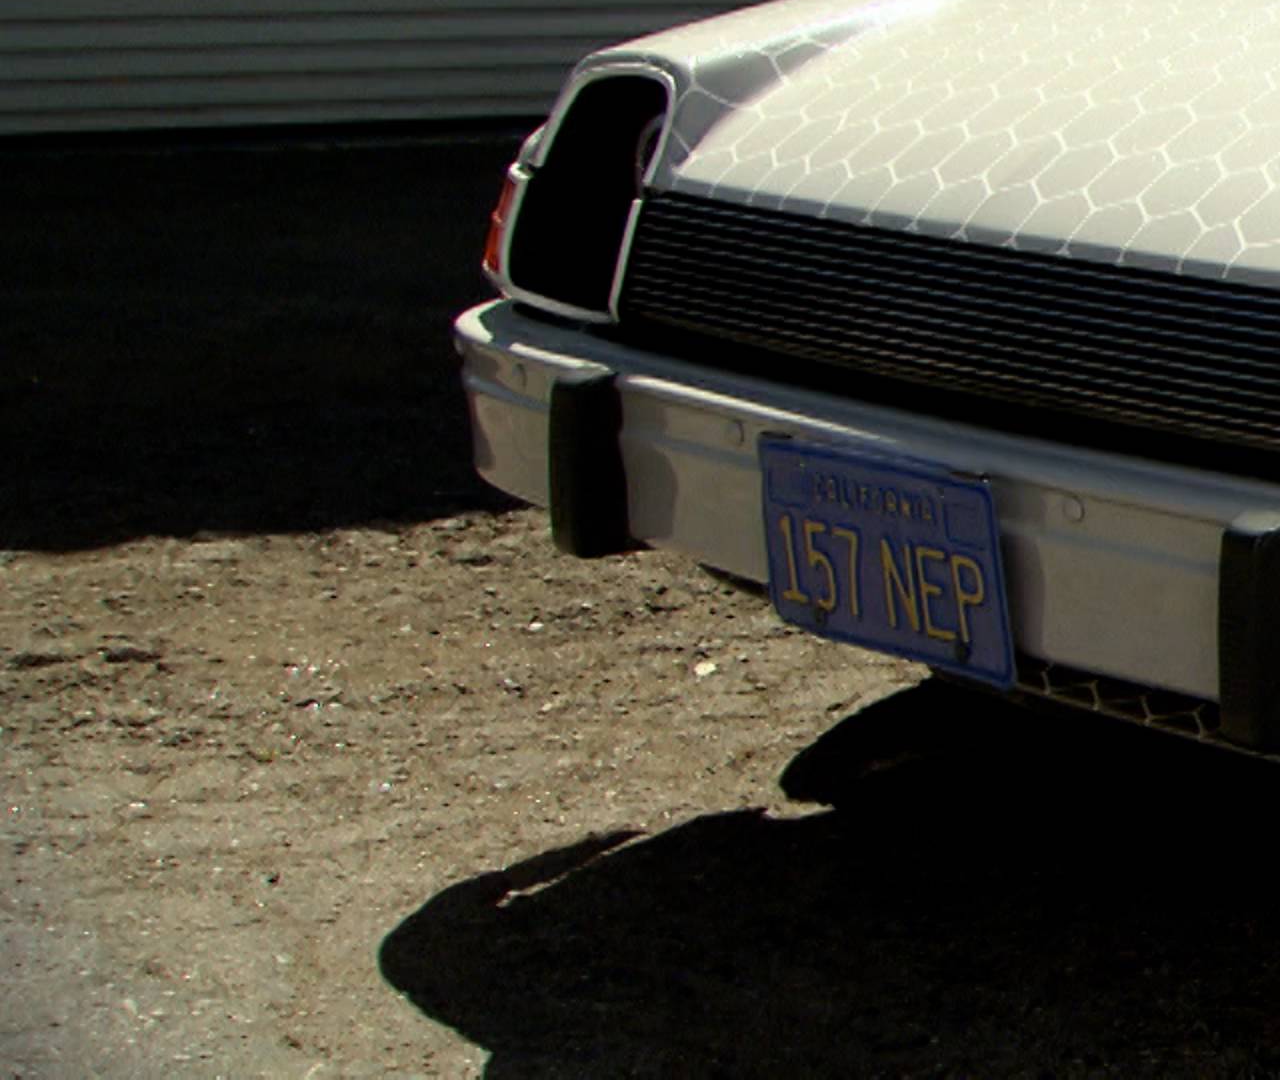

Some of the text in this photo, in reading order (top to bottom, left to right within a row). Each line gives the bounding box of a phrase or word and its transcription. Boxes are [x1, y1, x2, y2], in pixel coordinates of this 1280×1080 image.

[814, 471, 940, 526] CALIFORNIA
[779, 514, 986, 644] 157 NEP
